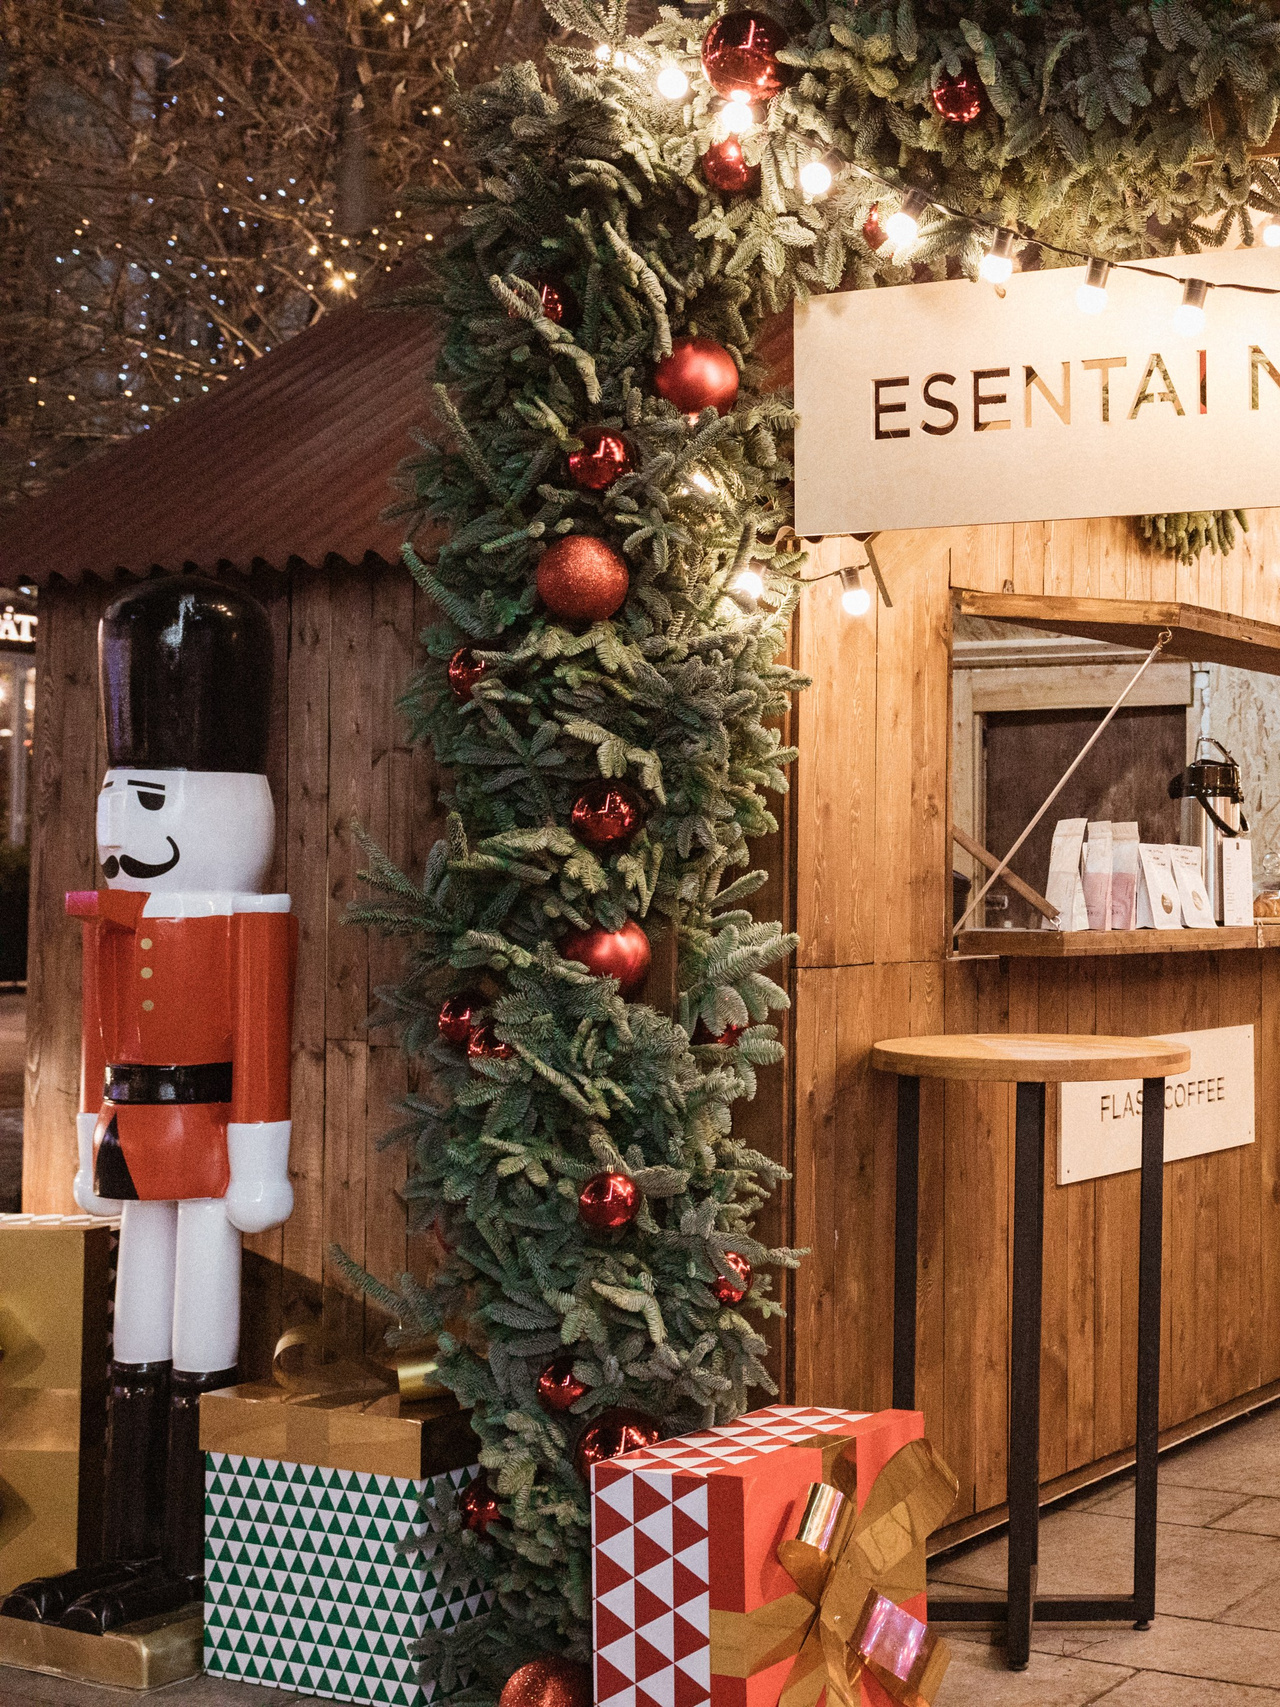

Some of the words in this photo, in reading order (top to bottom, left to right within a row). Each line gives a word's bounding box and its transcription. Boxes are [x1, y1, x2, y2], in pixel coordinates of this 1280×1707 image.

[872, 349, 1206, 440] ESENTAI
[1100, 1089, 1143, 1122] FLAS
[1164, 1076, 1226, 1111] COFFEE
